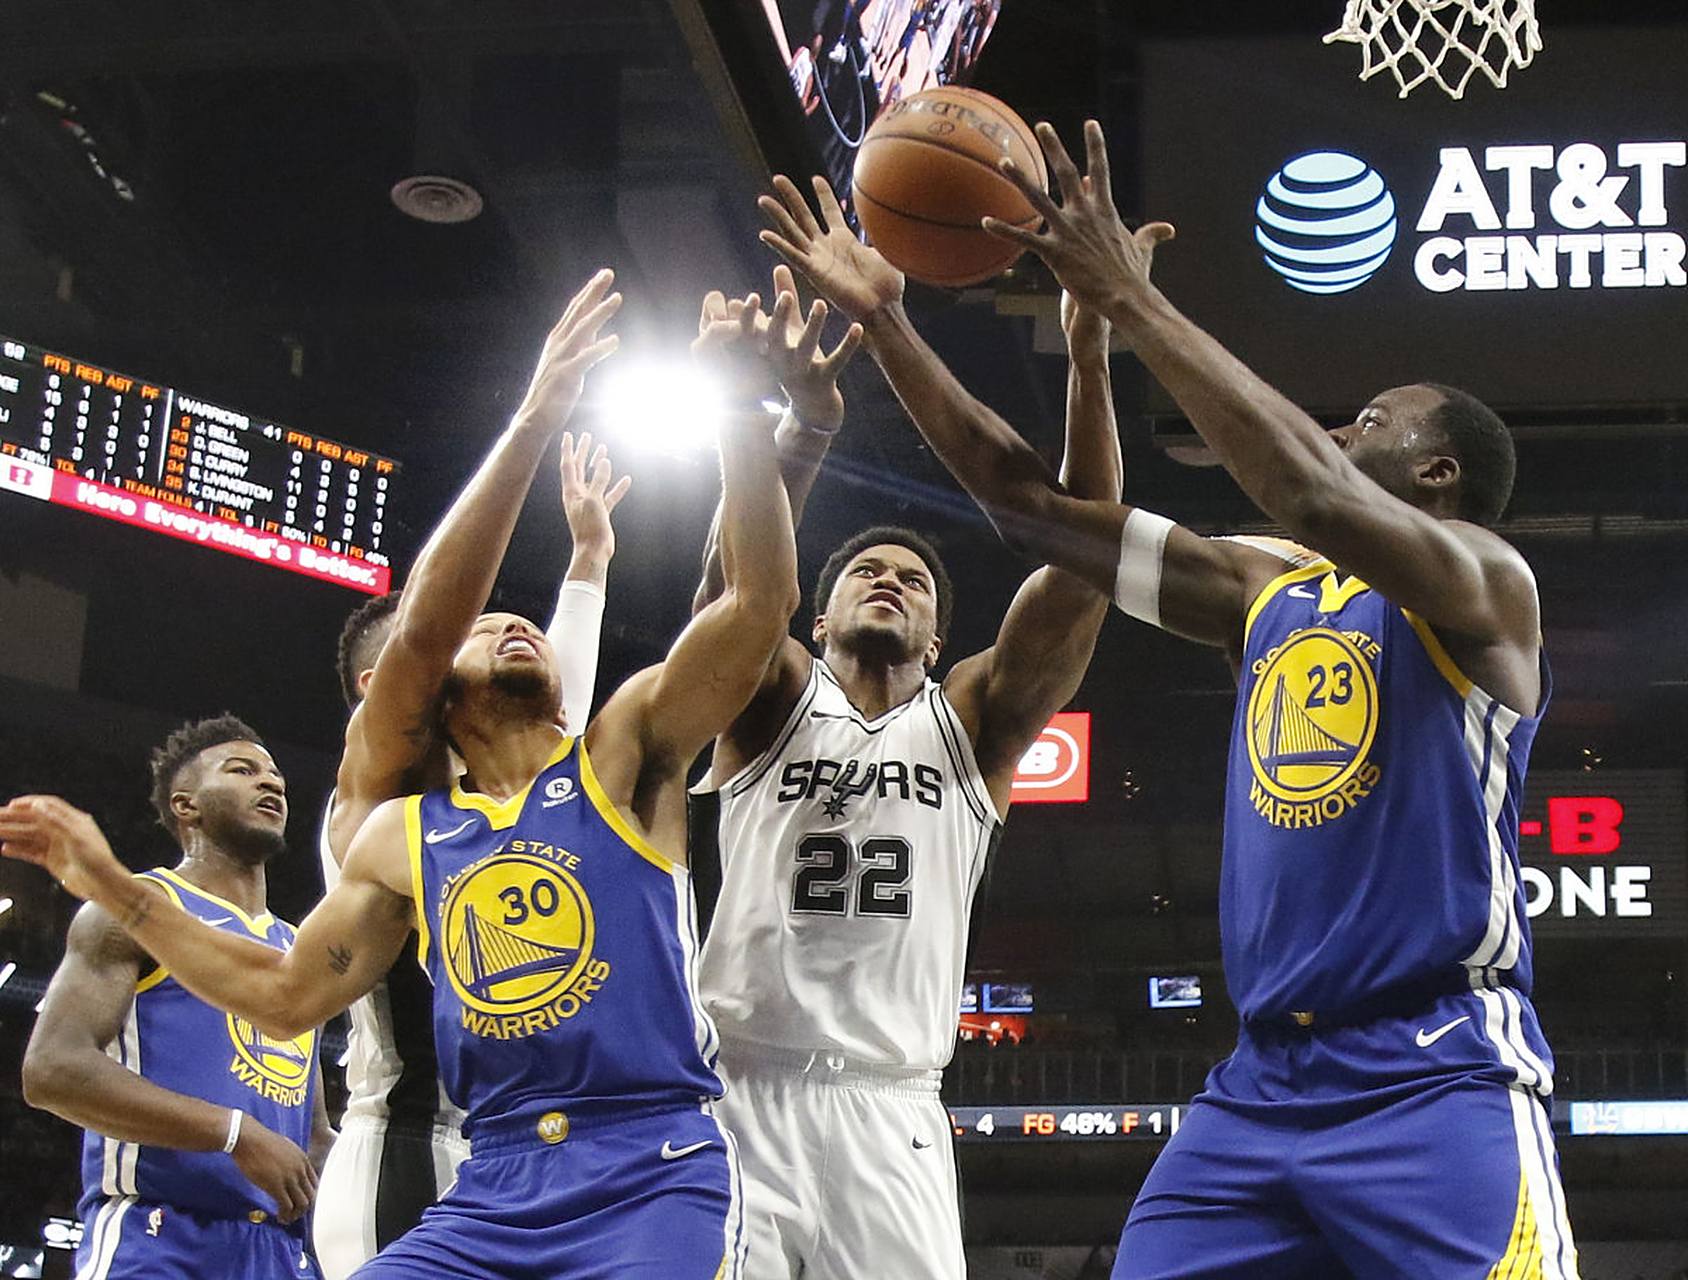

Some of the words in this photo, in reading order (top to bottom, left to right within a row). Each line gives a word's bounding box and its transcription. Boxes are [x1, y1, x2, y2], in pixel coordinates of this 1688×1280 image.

[1416, 142, 1687, 232] AT&T
[1413, 232, 1688, 293] CENTER
[44, 354, 71, 375] PTS
[75, 364, 103, 384] REB
[106, 375, 133, 393] AST
[178, 397, 250, 431] WARRIORS
[262, 425, 282, 441] 41
[287, 431, 312, 450] PTS
[316, 441, 342, 459] REB
[343, 450, 369, 467] AST
[376, 460, 393, 474] PF
[208, 424, 238, 445] BELL
[208, 439, 250, 463] GREEN
[203, 470, 273, 501] LIVINGSTON
[204, 454, 248, 478] CURRY
[125, 480, 155, 498] TEAM
[157, 489, 192, 509] FOULS
[201, 485, 254, 510] DURANT
[77, 481, 137, 516] Here
[144, 501, 291, 562] Everything's
[299, 547, 377, 586] Better.
[1306, 662, 1353, 708] 23
[777, 759, 943, 810] SPURS
[1249, 761, 1382, 829] WARRIORS
[511, 840, 581, 871] STATE
[790, 832, 913, 918] 22
[498, 879, 559, 925] 30
[1520, 866, 1652, 918] ONE
[461, 958, 611, 1040] WARRIORS
[230, 1054, 307, 1107] WARRIO
[976, 1113, 995, 1136] 4
[1023, 1114, 1056, 1134] FG
[1122, 1112, 1140, 1134] F
[1148, 1111, 1162, 1133] 1
